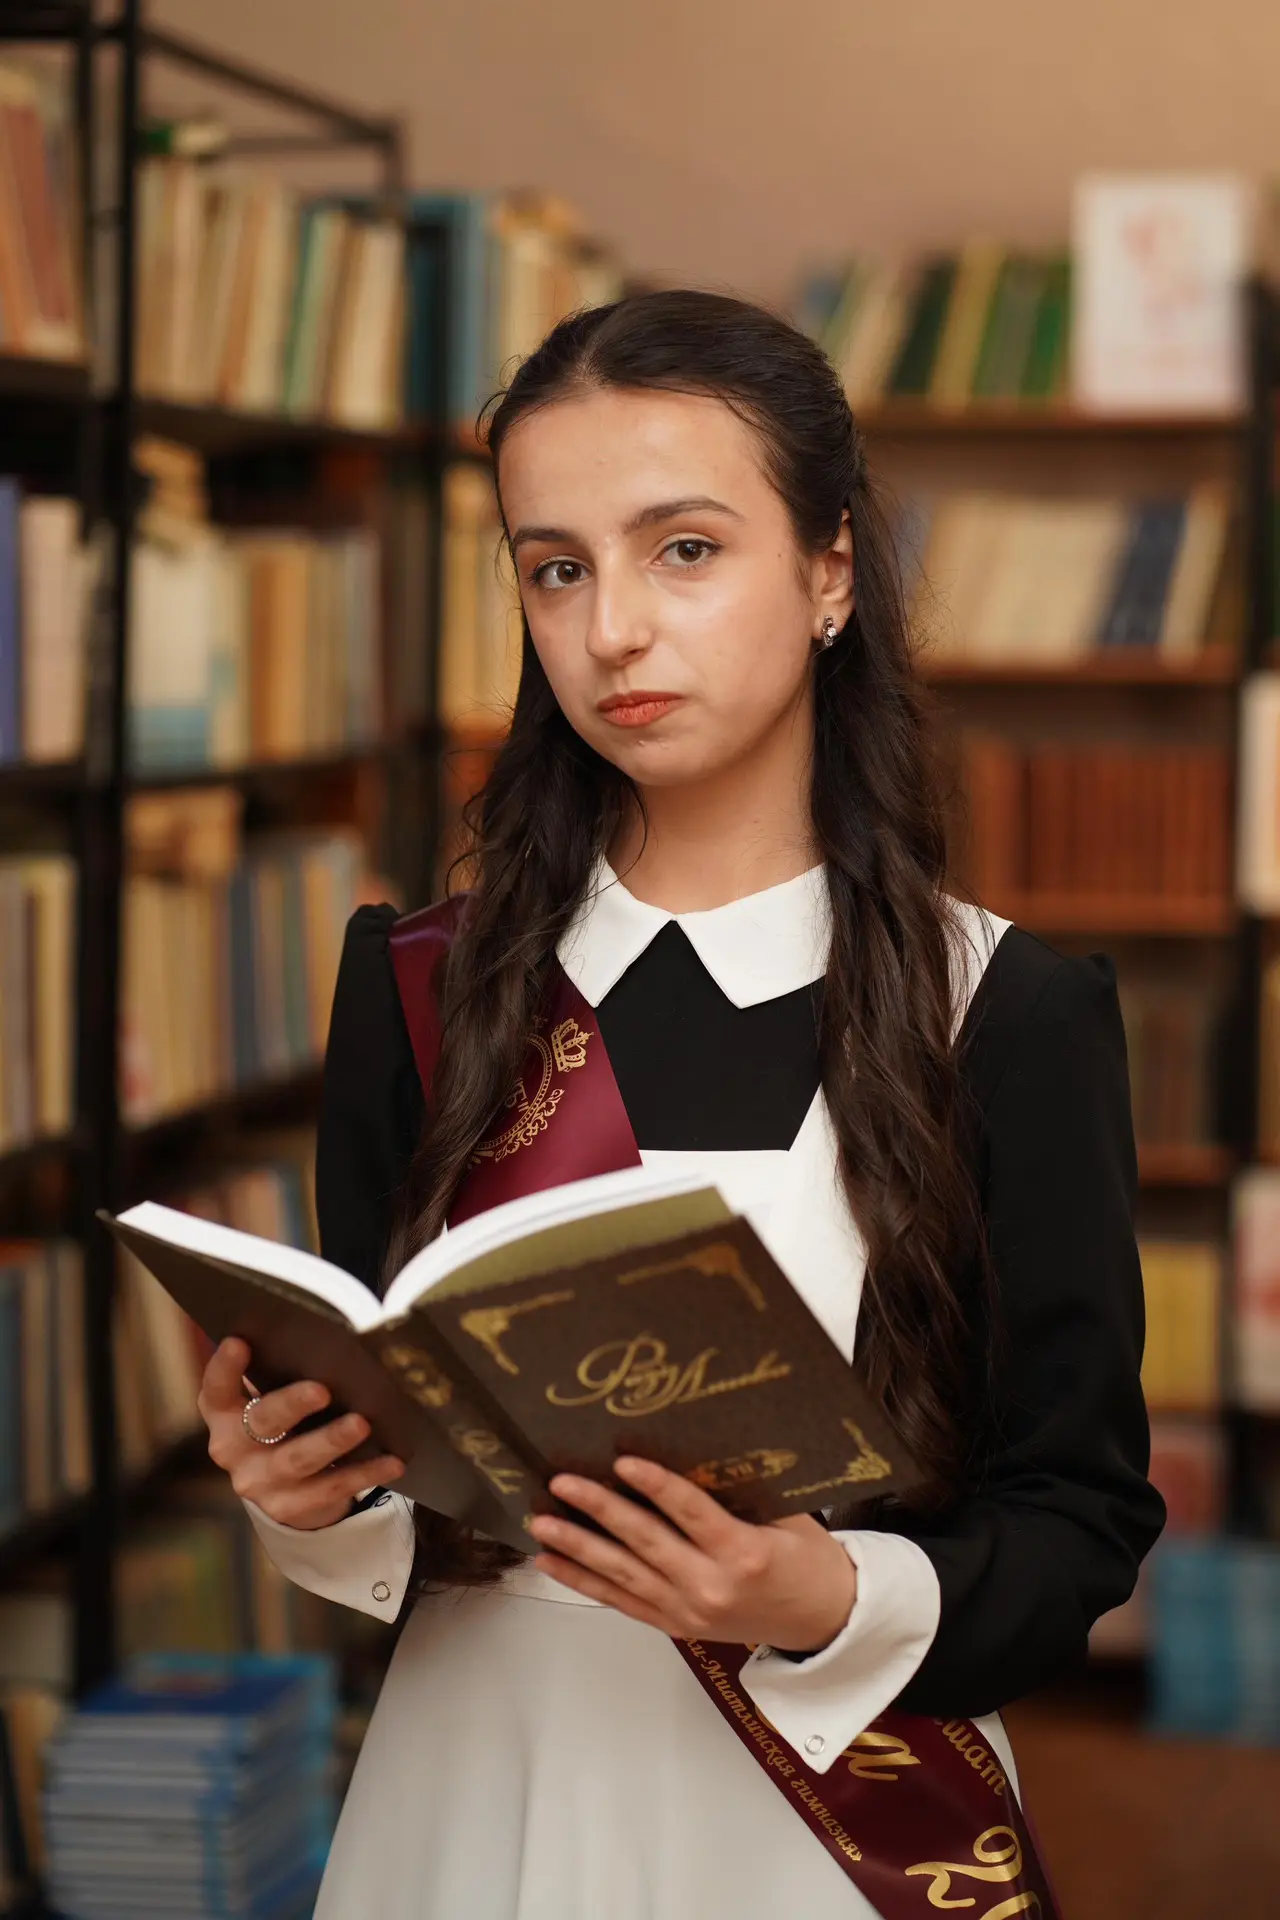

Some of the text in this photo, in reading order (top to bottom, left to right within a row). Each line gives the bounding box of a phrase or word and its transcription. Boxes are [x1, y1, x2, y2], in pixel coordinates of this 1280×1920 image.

[683, 1636, 864, 1863] ли-Миатлинская гимназия»
[933, 1716, 1008, 1797] шат
